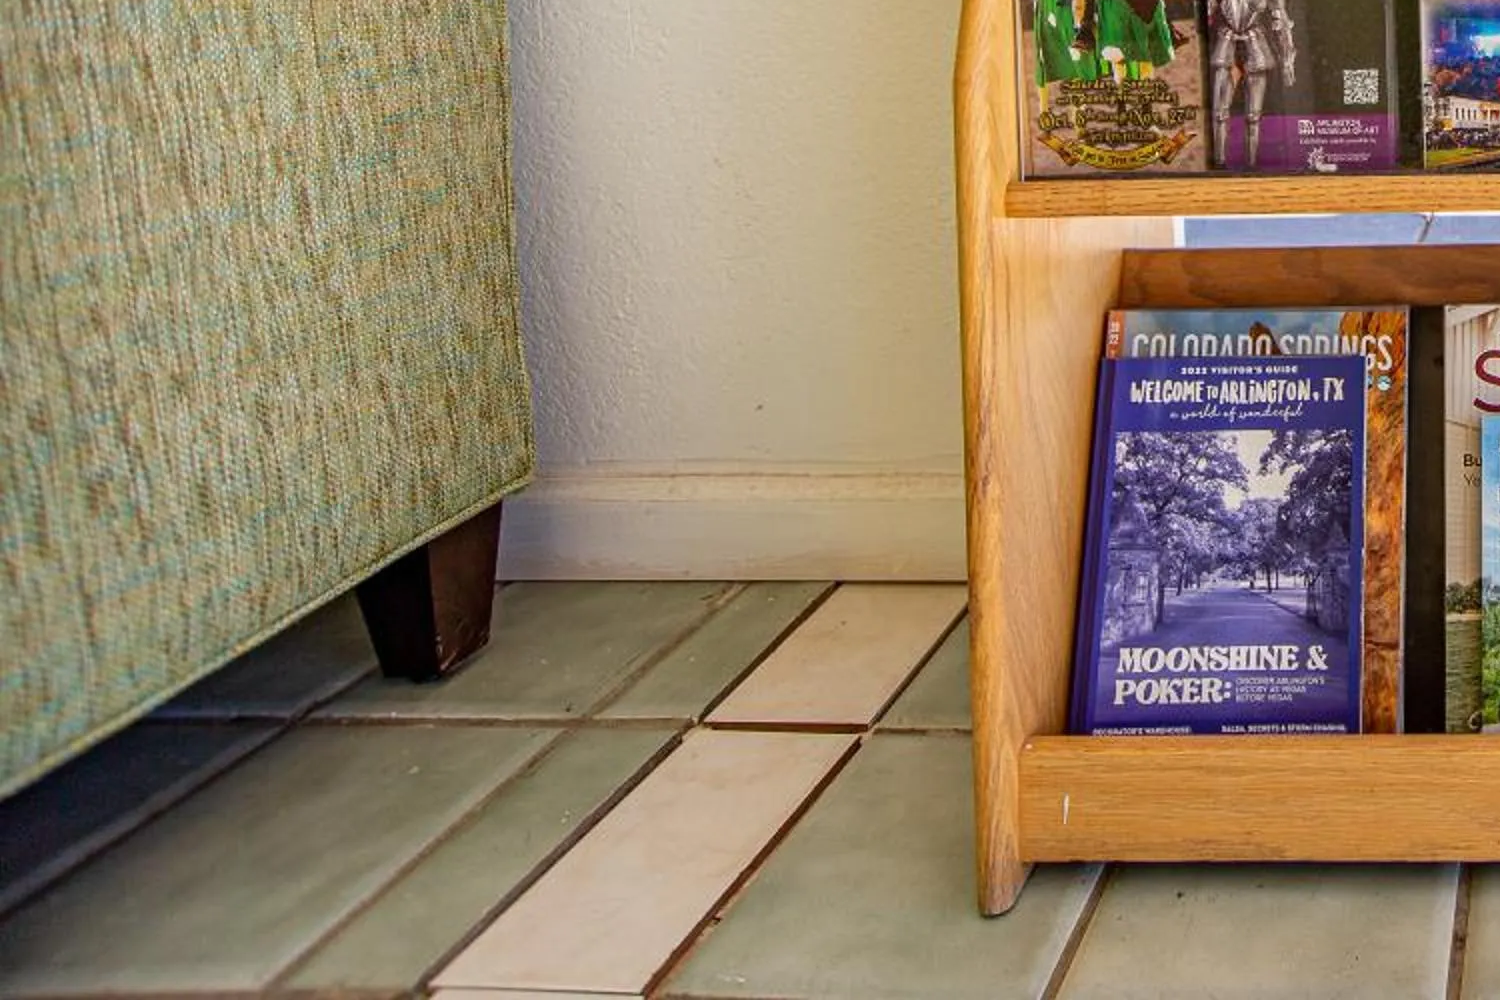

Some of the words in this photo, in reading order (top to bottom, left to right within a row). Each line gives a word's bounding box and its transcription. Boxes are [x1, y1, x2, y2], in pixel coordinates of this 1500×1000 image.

[1211, 365, 1263, 375] VISITOR'S
[1265, 365, 1299, 374] GUIDE
[1129, 380, 1204, 404] WELCOME
[1207, 386, 1219, 399] TO
[1323, 377, 1346, 402] TX
[1182, 403, 1219, 421] world
[1222, 405, 1235, 423] of
[1238, 402, 1304, 422] wonderful
[1116, 645, 1300, 673] MOONSHINE
[1306, 644, 1329, 671] &
[1113, 677, 1232, 706] POKER:
